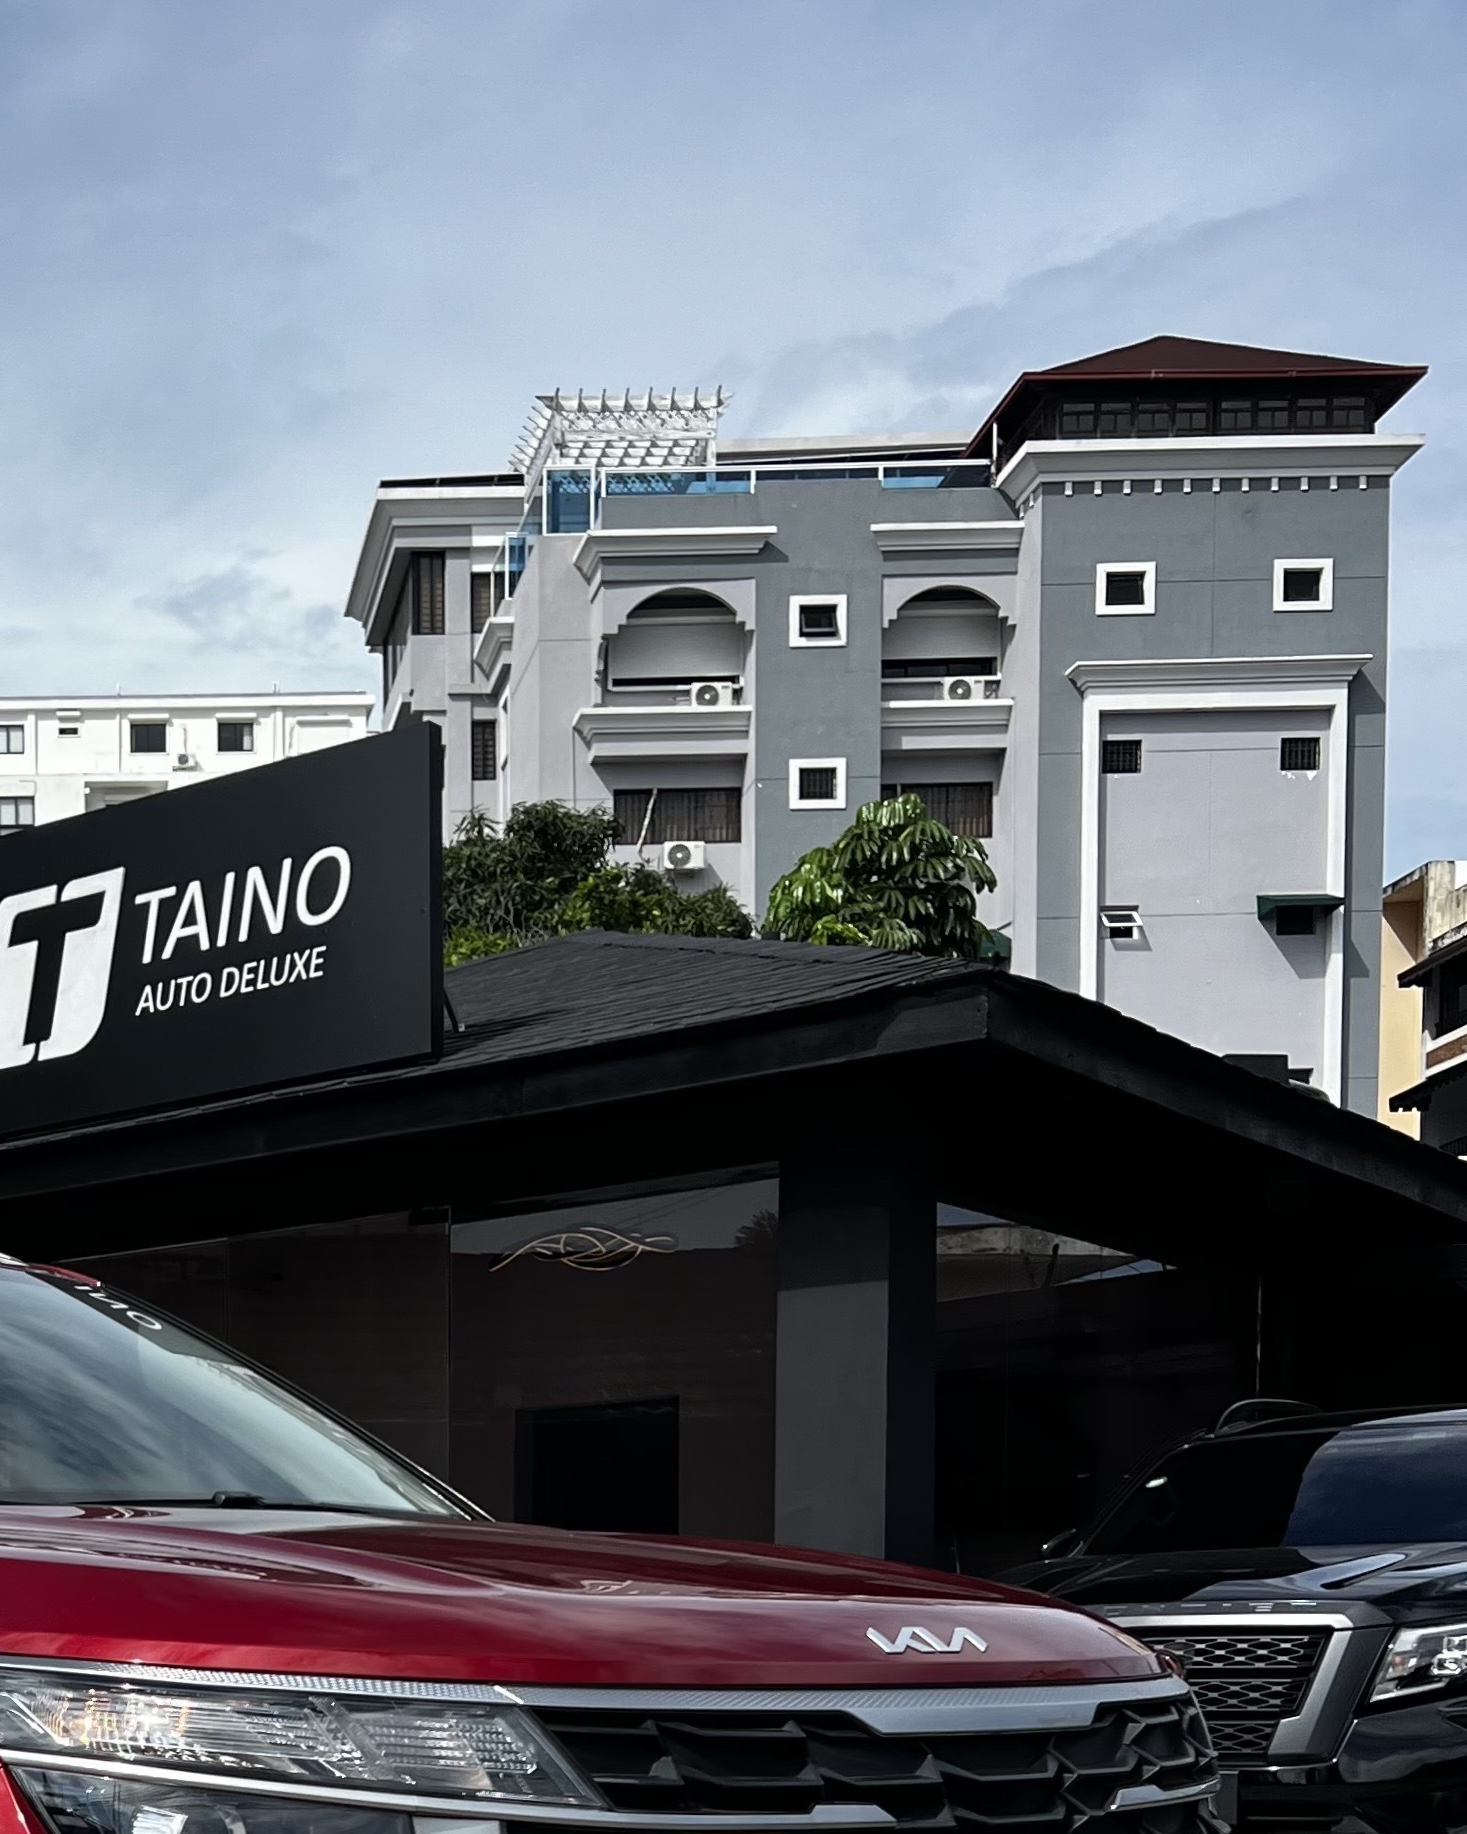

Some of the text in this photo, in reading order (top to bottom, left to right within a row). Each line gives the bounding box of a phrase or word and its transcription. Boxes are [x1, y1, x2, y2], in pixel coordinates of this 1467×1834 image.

[134, 846, 351, 964] TAINO
[135, 946, 327, 1016] AUTO DELUXE
